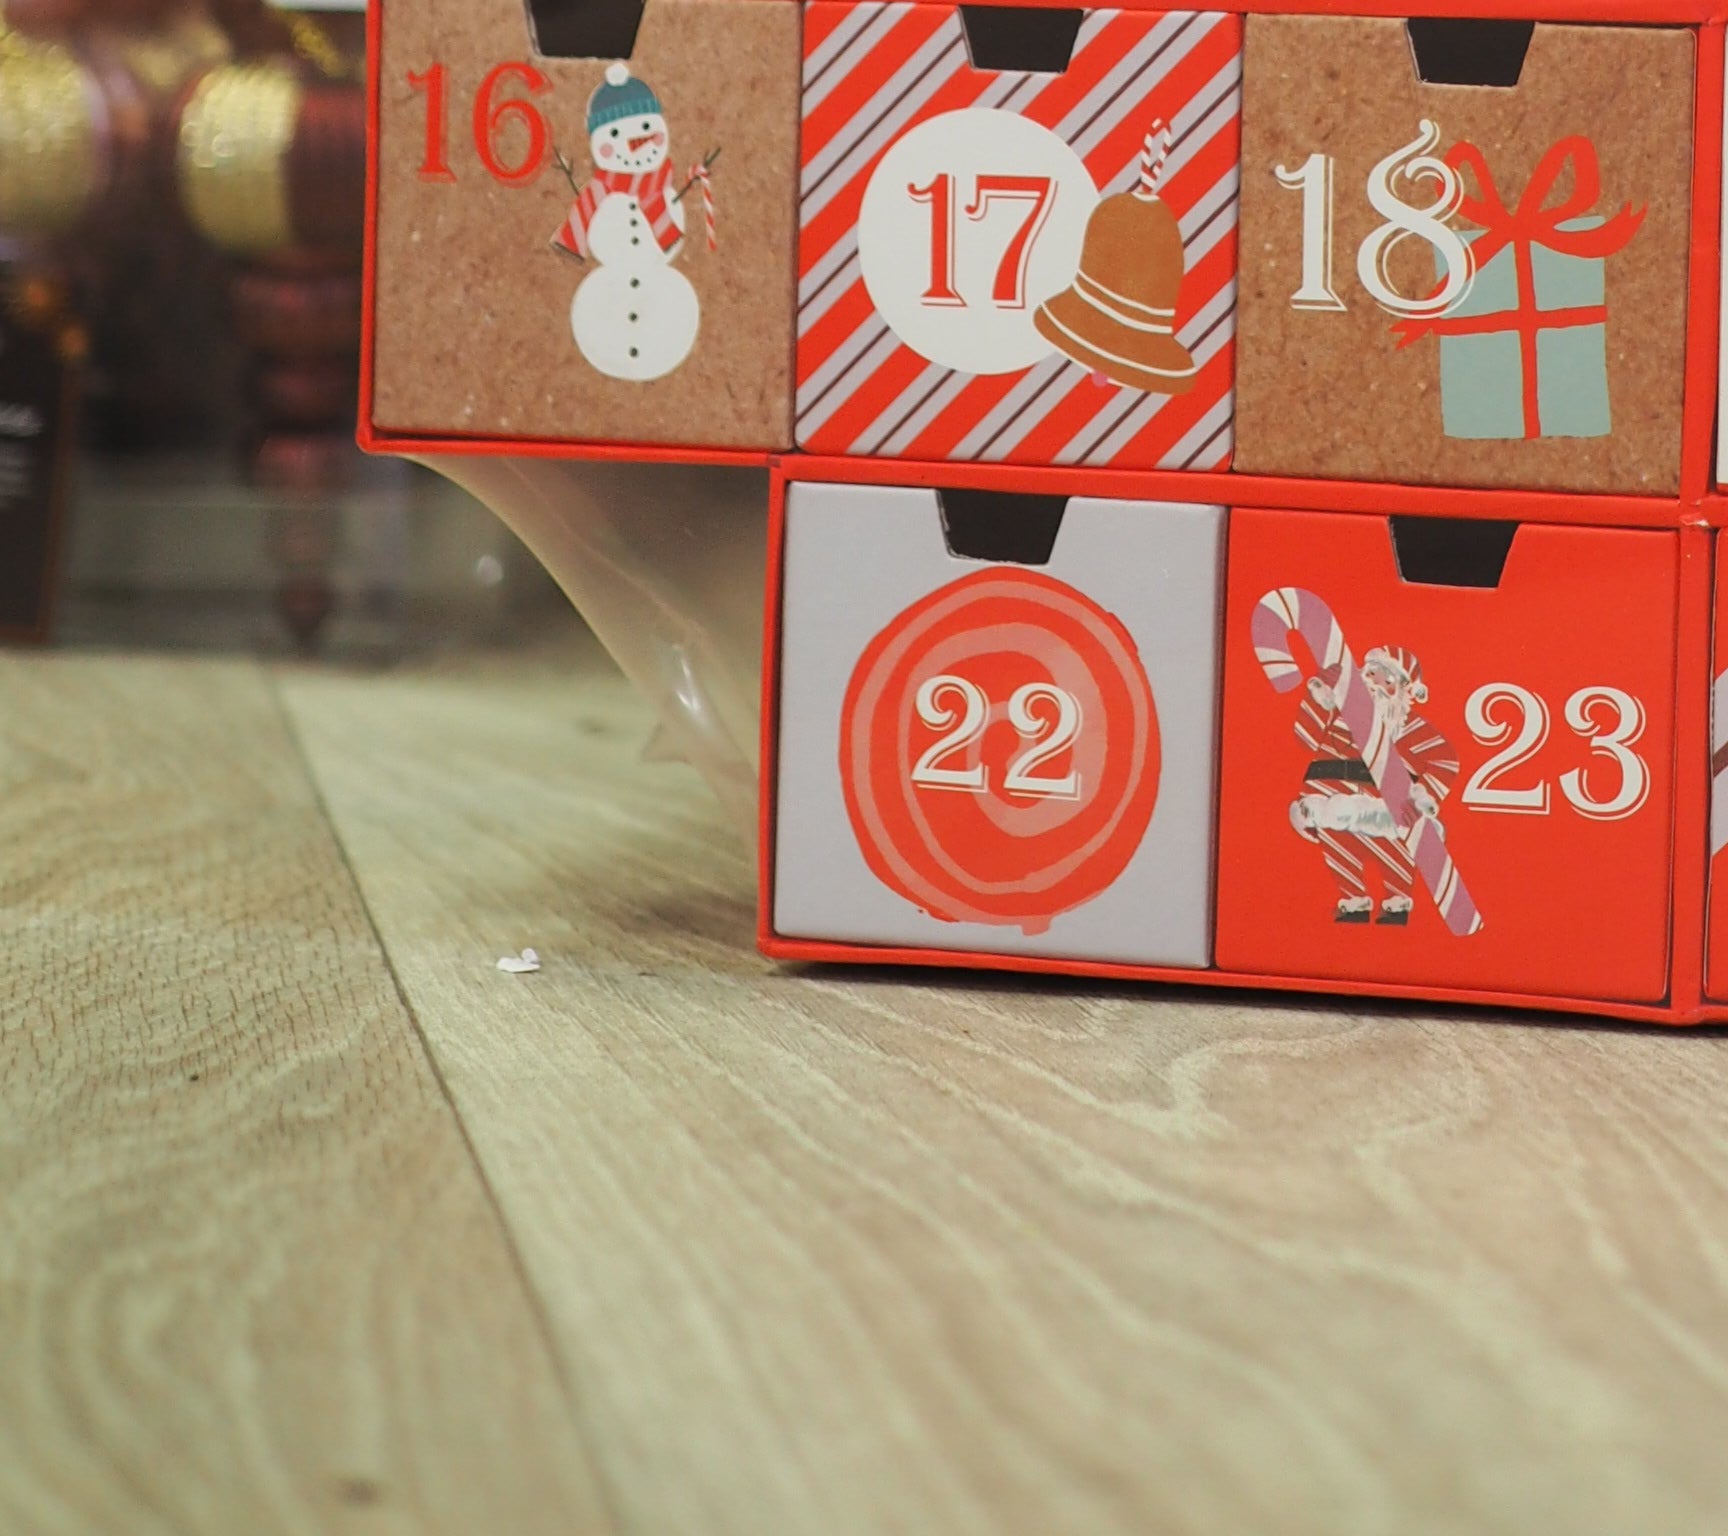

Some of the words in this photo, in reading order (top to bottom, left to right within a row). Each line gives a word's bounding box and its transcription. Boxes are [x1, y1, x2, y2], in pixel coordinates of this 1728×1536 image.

[406, 61, 553, 184] 16
[907, 172, 1059, 310] 17
[1275, 119, 1479, 319] 18
[910, 674, 1082, 803] 22
[1462, 681, 1649, 819] 23
